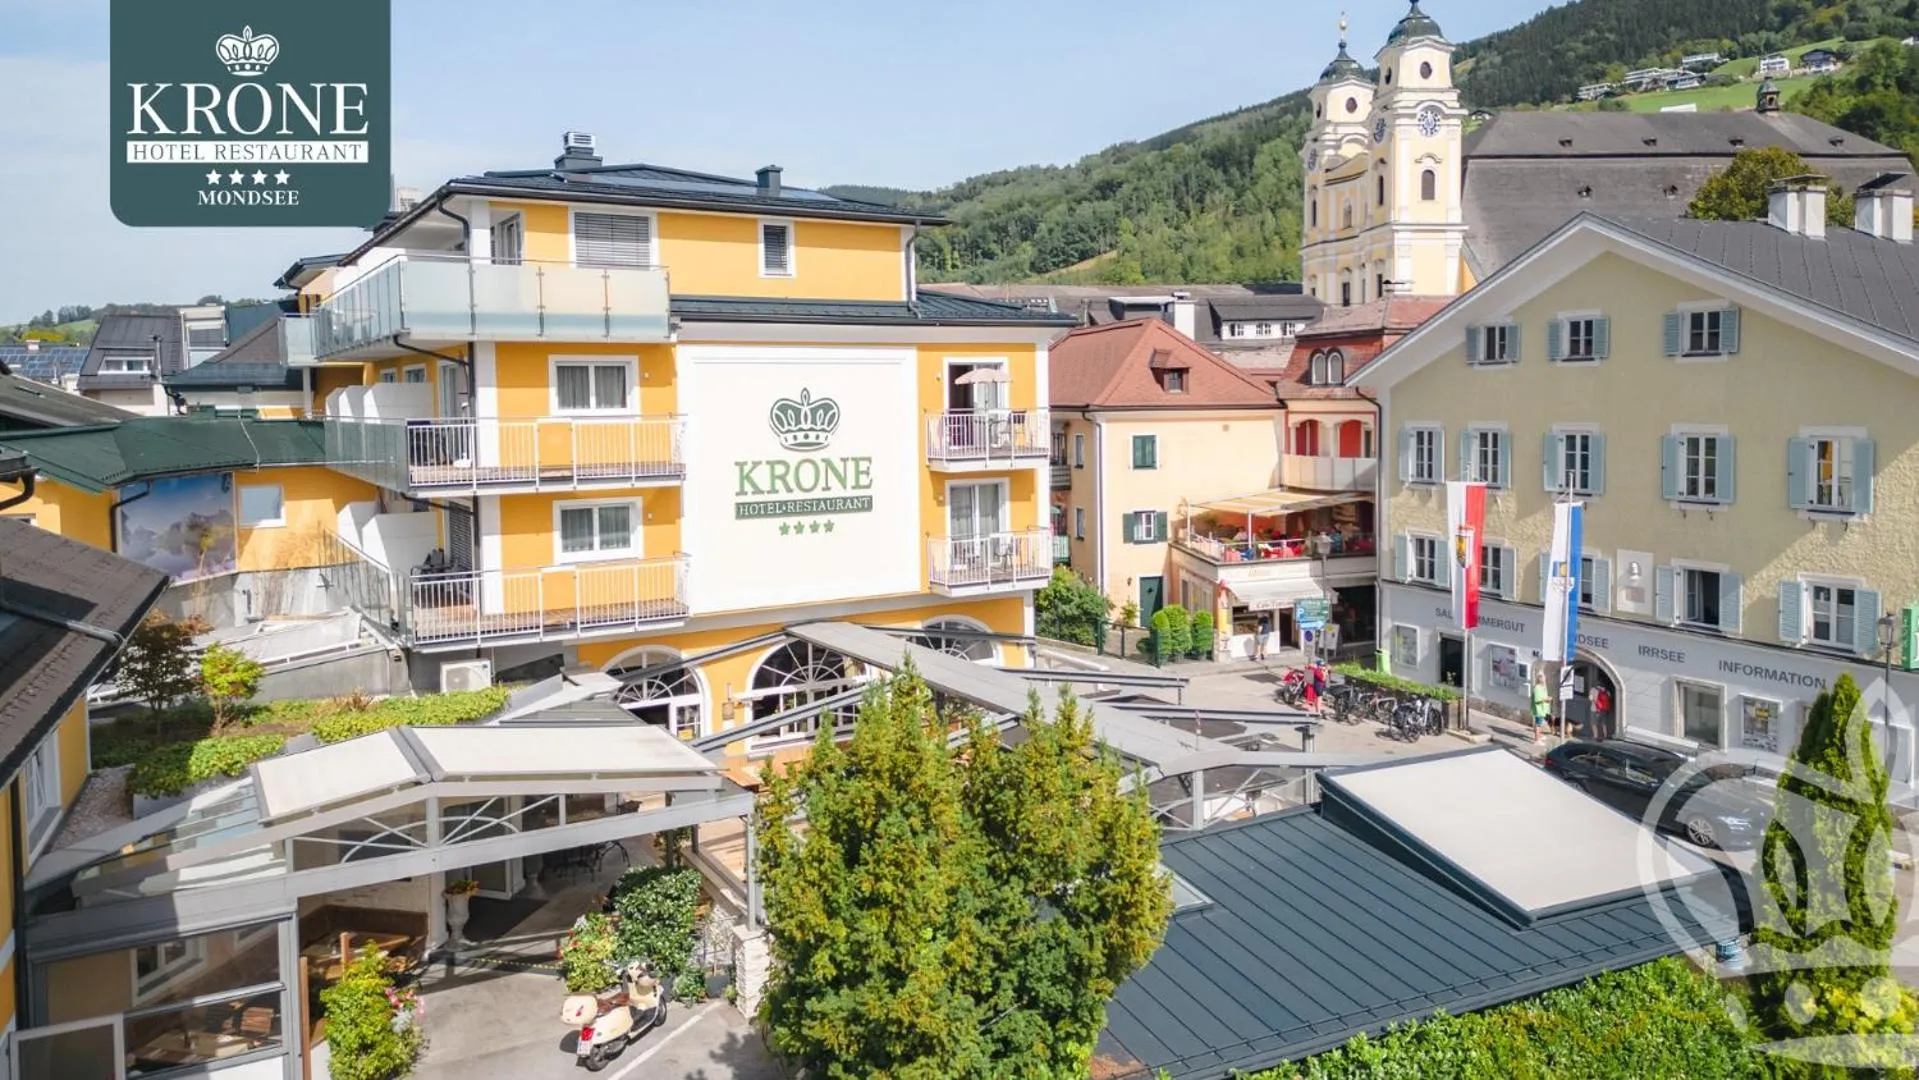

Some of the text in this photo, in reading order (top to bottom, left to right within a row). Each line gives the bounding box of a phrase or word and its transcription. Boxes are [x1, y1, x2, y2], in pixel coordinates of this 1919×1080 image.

[734, 456, 873, 497] KRONE
[1638, 644, 1686, 663] IRRSEE
[1719, 660, 1826, 689] INFORMATION
